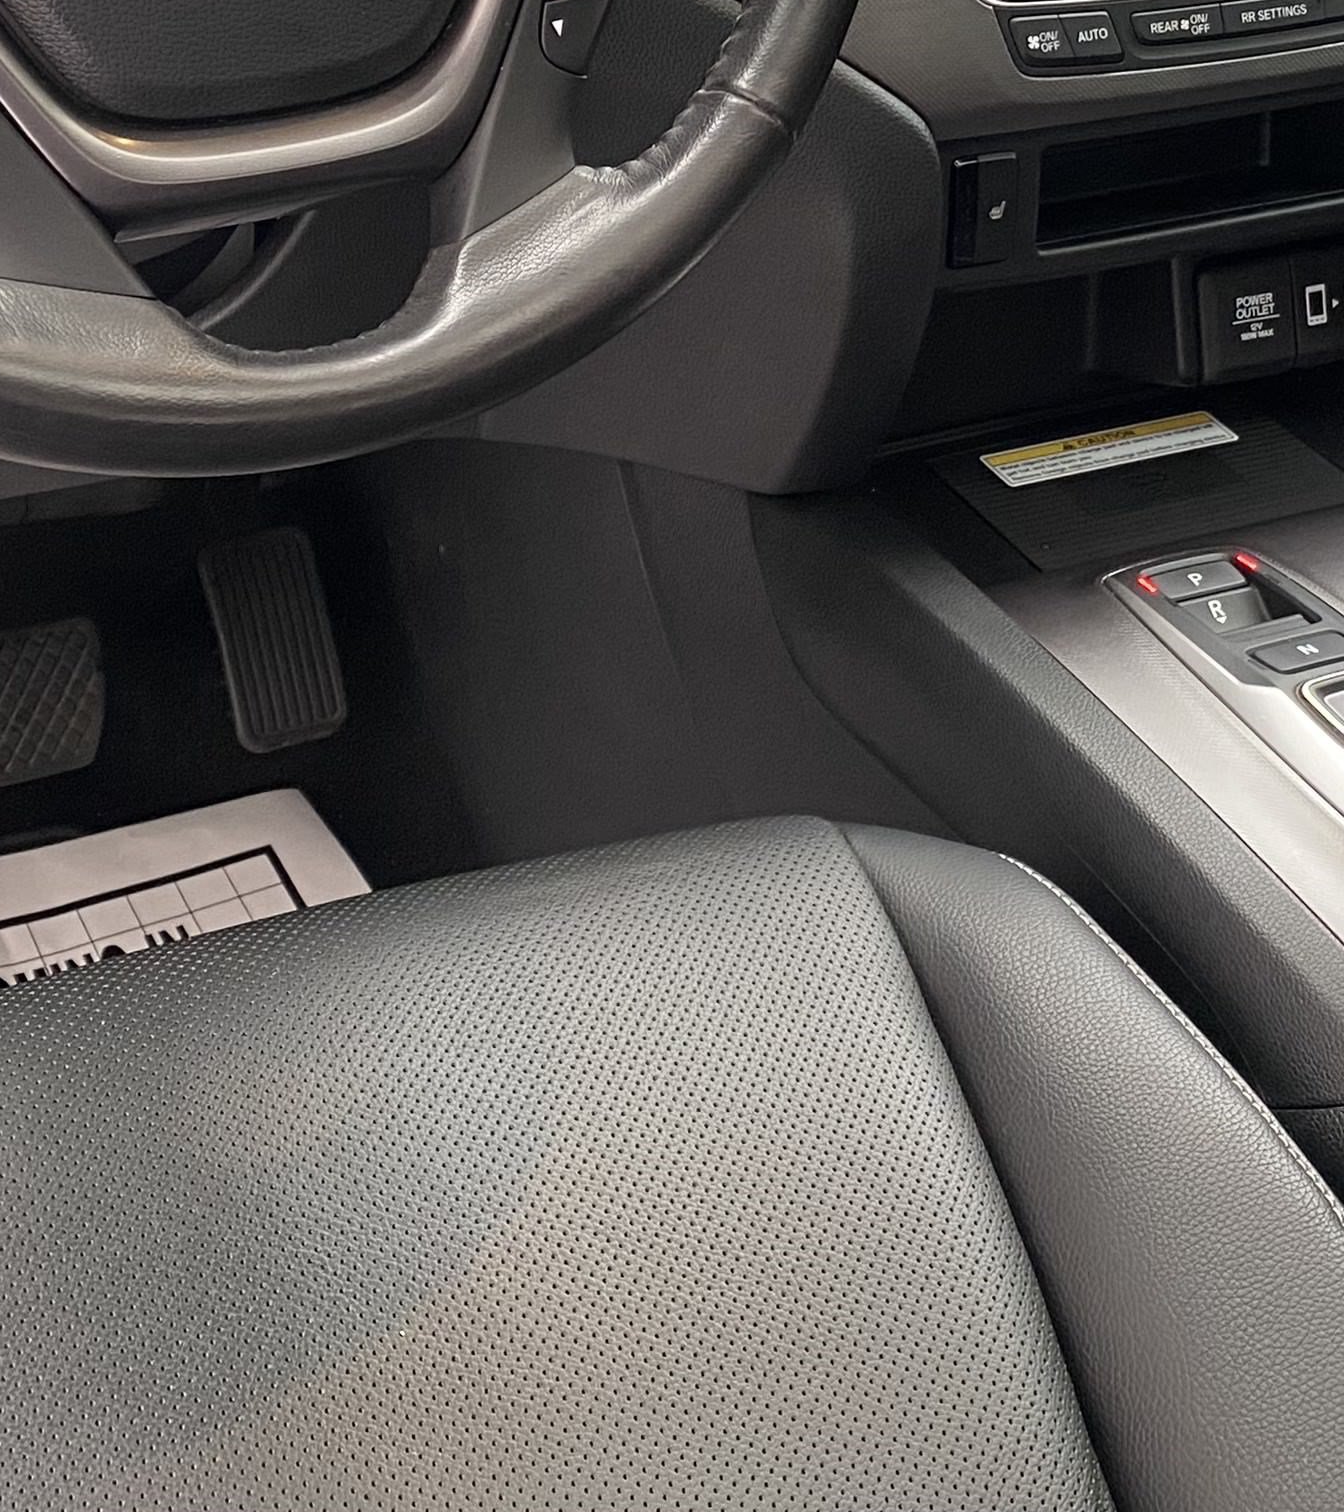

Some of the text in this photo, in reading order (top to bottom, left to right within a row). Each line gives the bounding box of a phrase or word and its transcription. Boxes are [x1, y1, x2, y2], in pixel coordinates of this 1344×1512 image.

[1241, 3, 1307, 24] RR SETTINGS
[1150, 20, 1179, 34] REAR
[1191, 24, 1211, 35] OFF
[1077, 28, 1109, 43] AUTO
[1040, 41, 1061, 53] OFF
[1235, 292, 1273, 308] POWER
[1235, 302, 1275, 320] OUTLET
[1188, 572, 1203, 586] P
[1208, 599, 1224, 619] R
[1297, 642, 1319, 656] N
